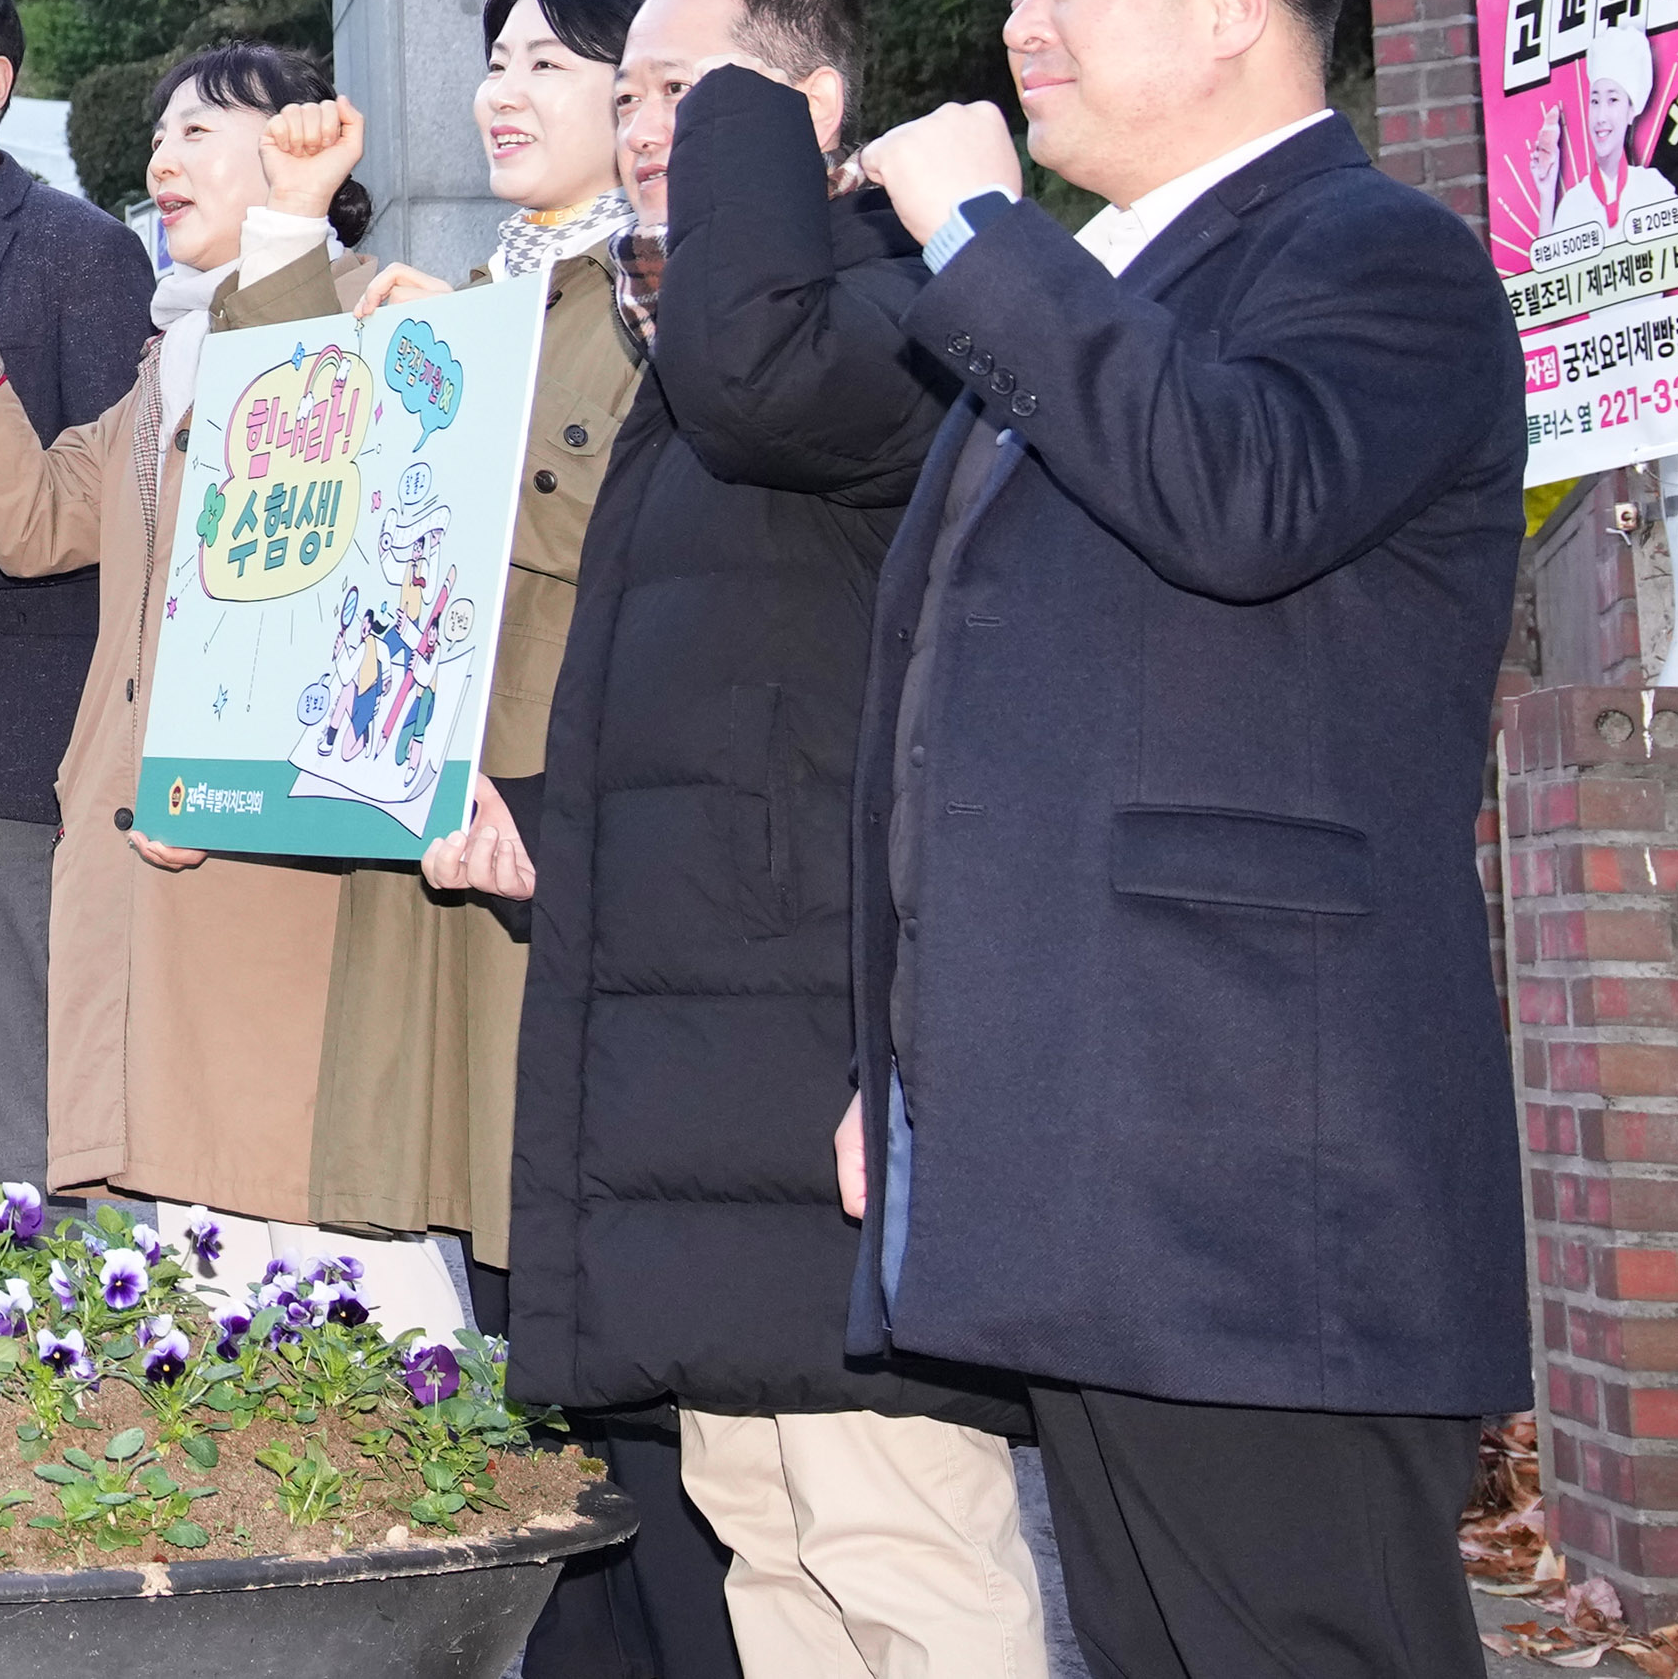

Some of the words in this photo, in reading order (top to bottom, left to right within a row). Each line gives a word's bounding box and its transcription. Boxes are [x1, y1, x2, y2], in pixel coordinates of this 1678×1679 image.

[1534, 242, 1561, 262] 취업시
[1562, 230, 1600, 255] 500만원
[1509, 273, 1573, 317] 호텔조리
[1587, 249, 1654, 296] 제과제빵
[1563, 315, 1678, 383] 궁전요리제빵
[245, 382, 361, 479] 힘내라!
[1577, 401, 1592, 434] 옆
[226, 479, 343, 578] 수험생!
